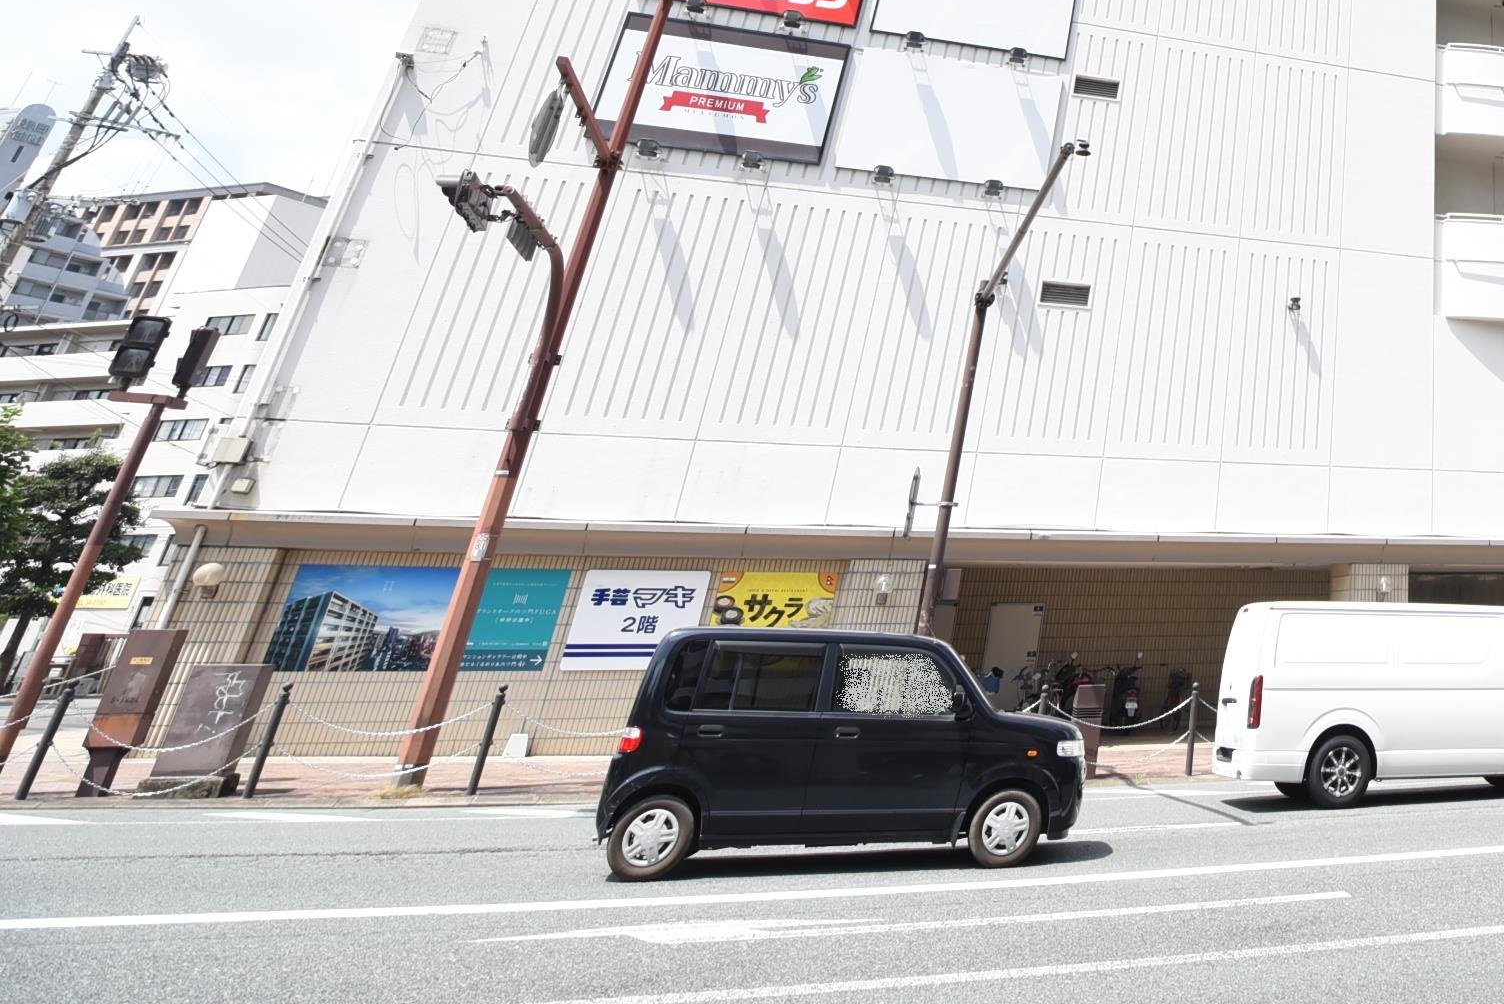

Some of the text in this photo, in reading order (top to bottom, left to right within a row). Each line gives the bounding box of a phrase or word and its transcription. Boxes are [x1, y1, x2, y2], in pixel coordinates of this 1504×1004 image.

[688, 96, 746, 112] PREMIUM
[590, 584, 697, 609] 手芸マキ
[743, 593, 805, 628] サクラ
[620, 614, 659, 635] 2階
